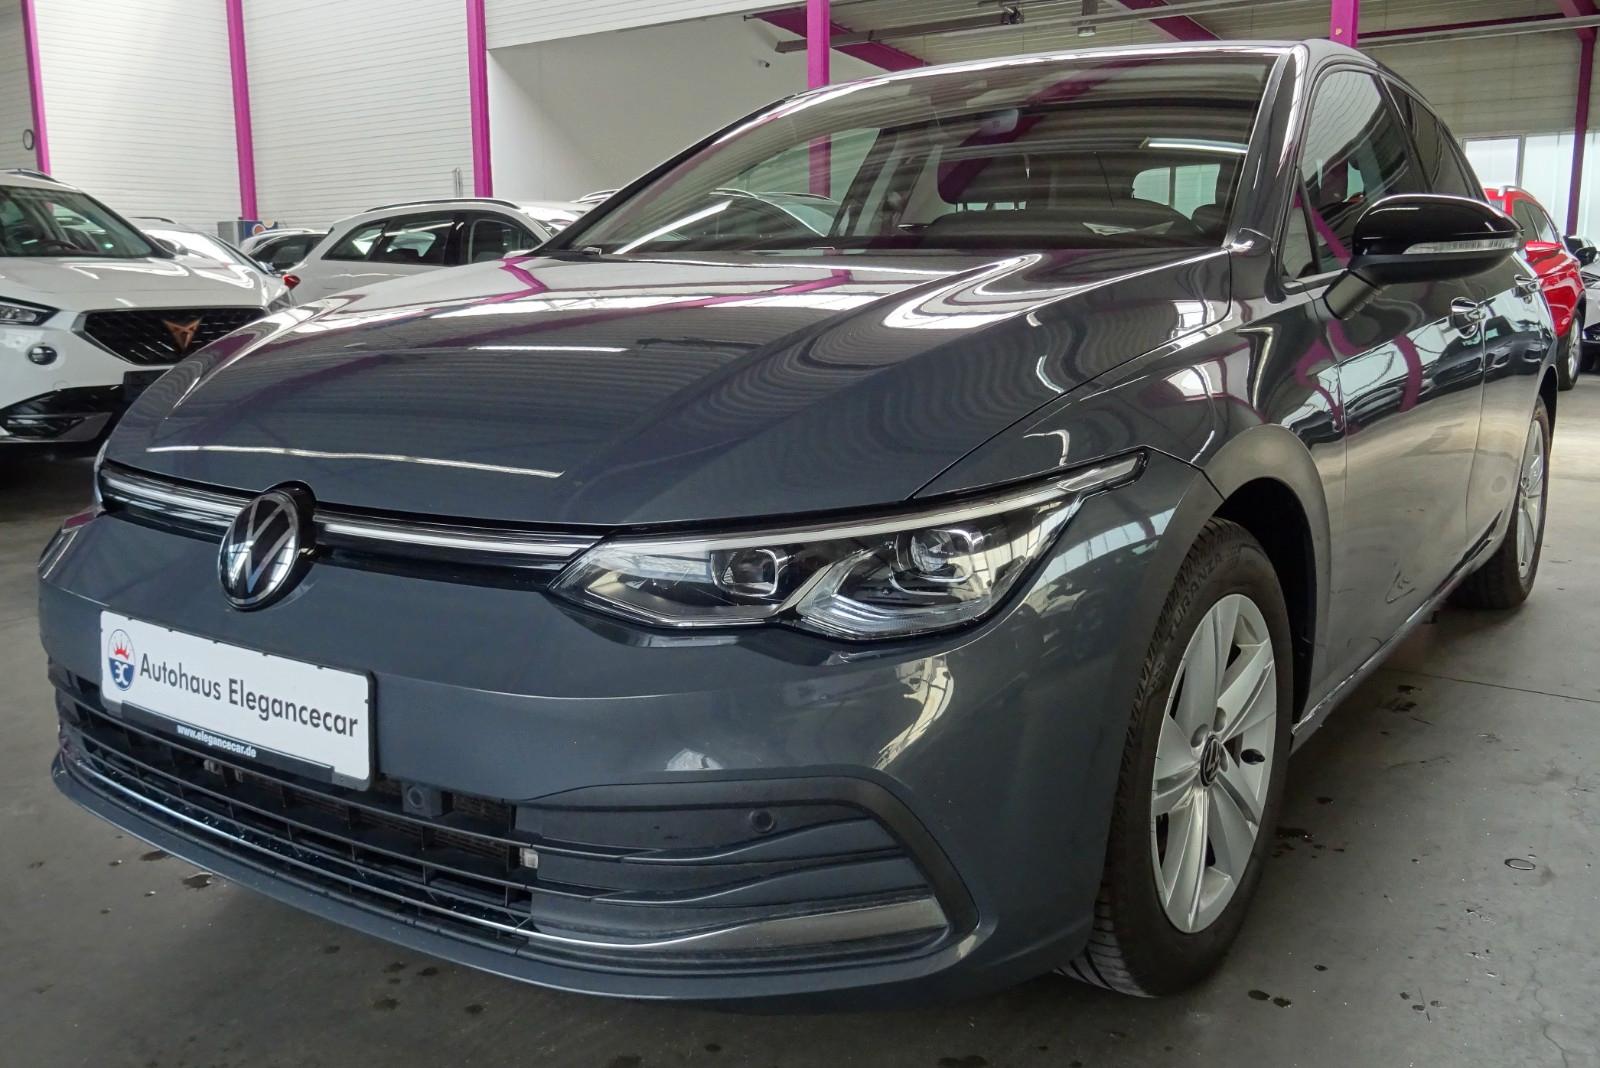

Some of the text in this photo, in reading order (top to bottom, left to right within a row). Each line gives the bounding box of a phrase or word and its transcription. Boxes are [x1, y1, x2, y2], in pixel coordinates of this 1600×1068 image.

[140, 652, 358, 737] Autohaus Elegancecar
[176, 724, 257, 758] www.elegancecar.de
